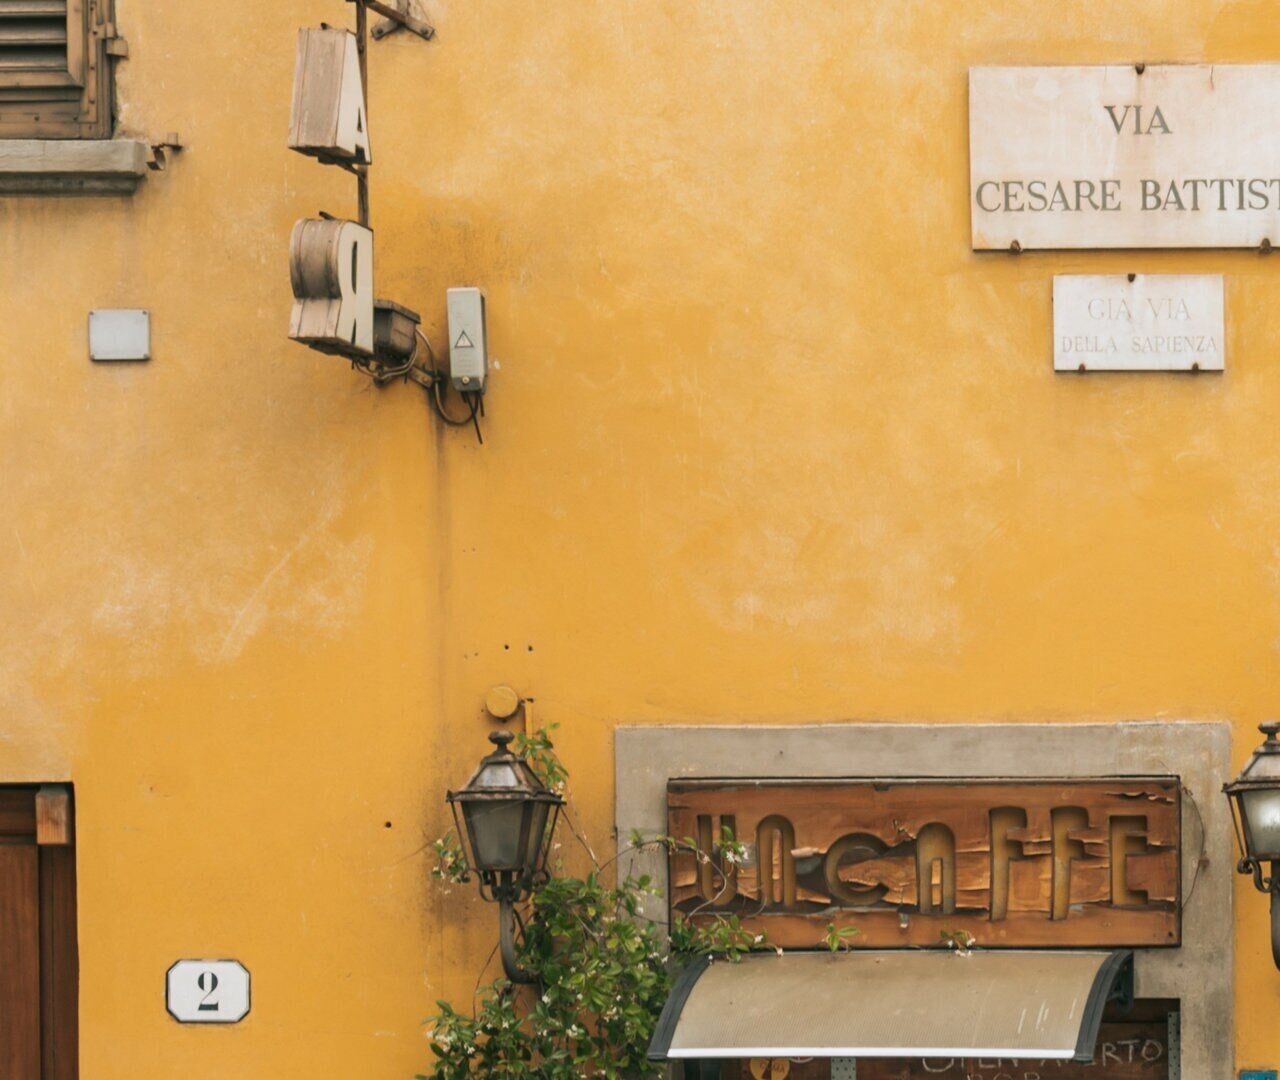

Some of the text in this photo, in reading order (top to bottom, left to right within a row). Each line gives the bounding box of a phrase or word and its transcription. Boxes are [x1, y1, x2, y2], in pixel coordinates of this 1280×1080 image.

[1104, 105, 1173, 135] VIA
[976, 180, 1122, 212] CESARE
[1148, 298, 1191, 321] VIA
[1061, 335, 1218, 353] DELLA SAPIENZA
[198, 971, 219, 1011] 2
